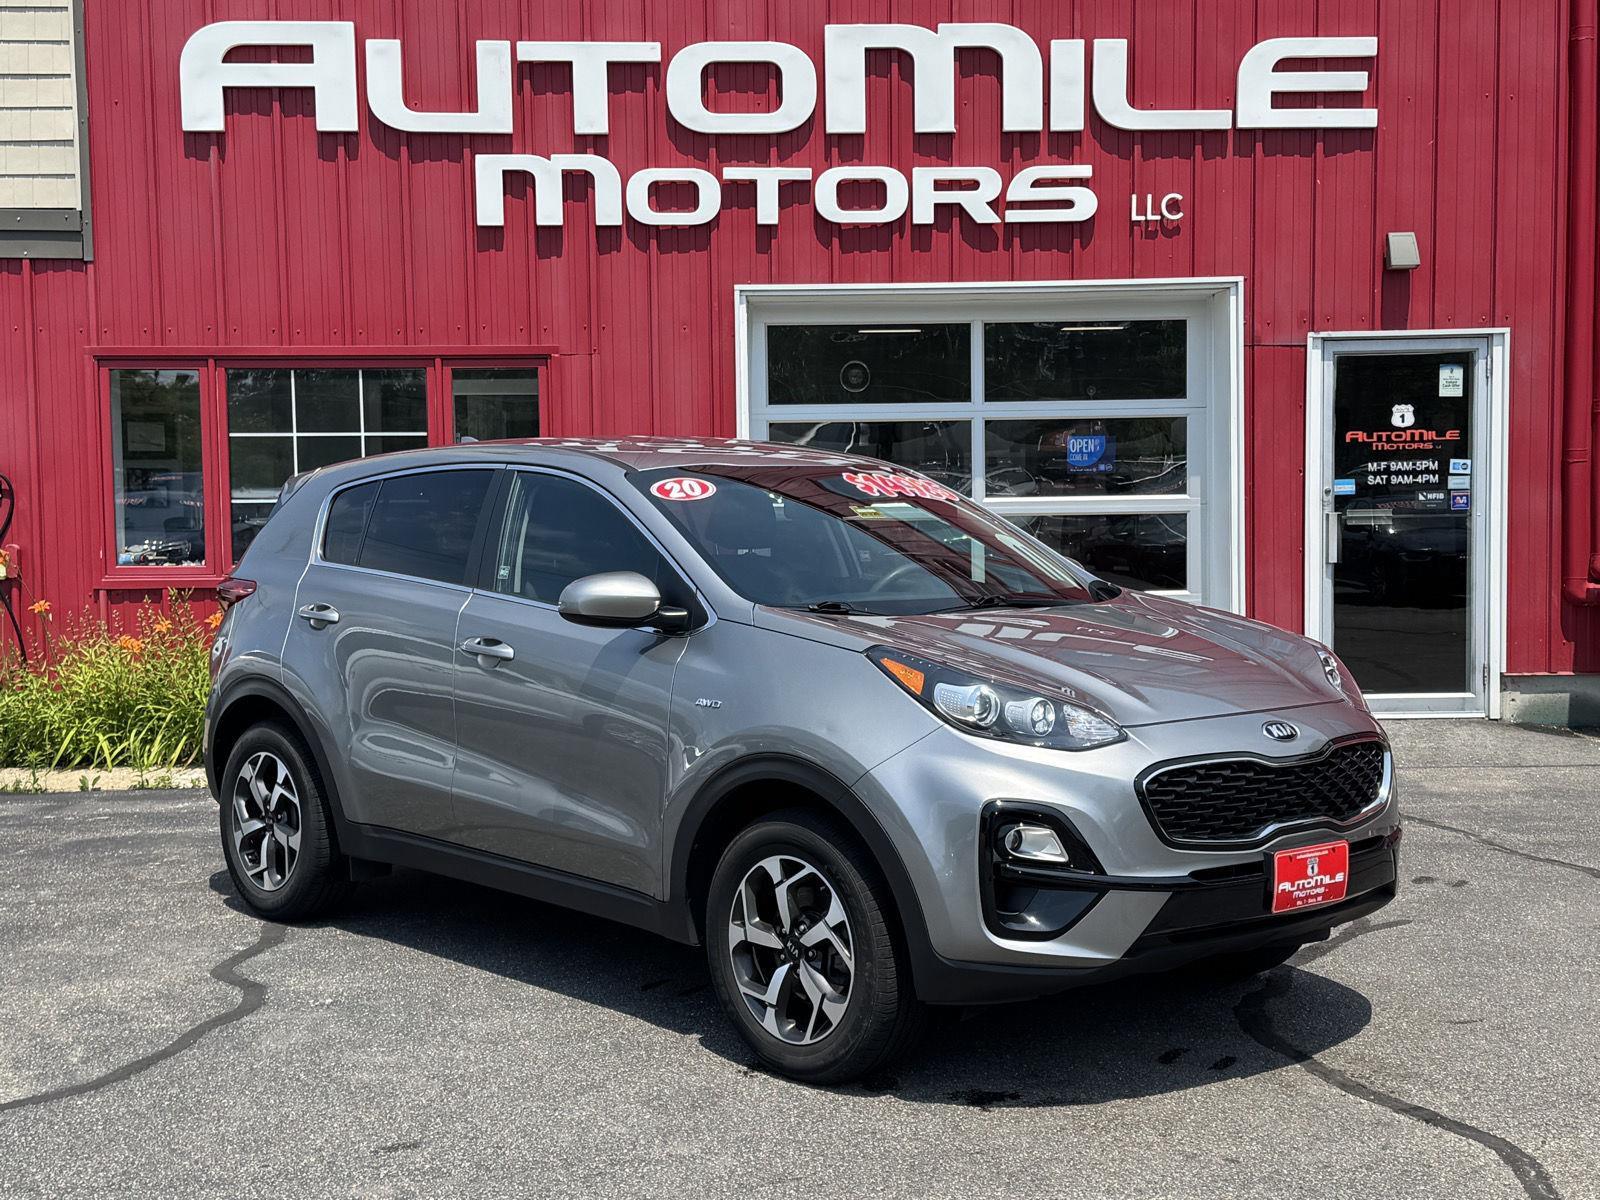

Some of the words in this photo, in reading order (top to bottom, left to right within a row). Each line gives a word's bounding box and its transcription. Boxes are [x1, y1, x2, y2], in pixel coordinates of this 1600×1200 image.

[180, 21, 1378, 135] AUTOMILE
[475, 153, 1099, 226] MOTORS
[1131, 193, 1184, 220] LLC
[1399, 414, 1405, 423] 1
[1345, 429, 1460, 442] AUTOMILE
[1069, 439, 1095, 453] OPEN
[1373, 442, 1433, 450] MOTORS
[1368, 462, 1387, 471] M-F
[1390, 461, 1439, 471] 9AM-5PM
[1367, 475, 1387, 485] SAT
[1390, 474, 1439, 484] 9AM-4PM
[664, 479, 702, 498] 20
[695, 698, 722, 708] AWD
[1267, 723, 1296, 737] KIA
[1278, 872, 1344, 893] AUTOMILE
